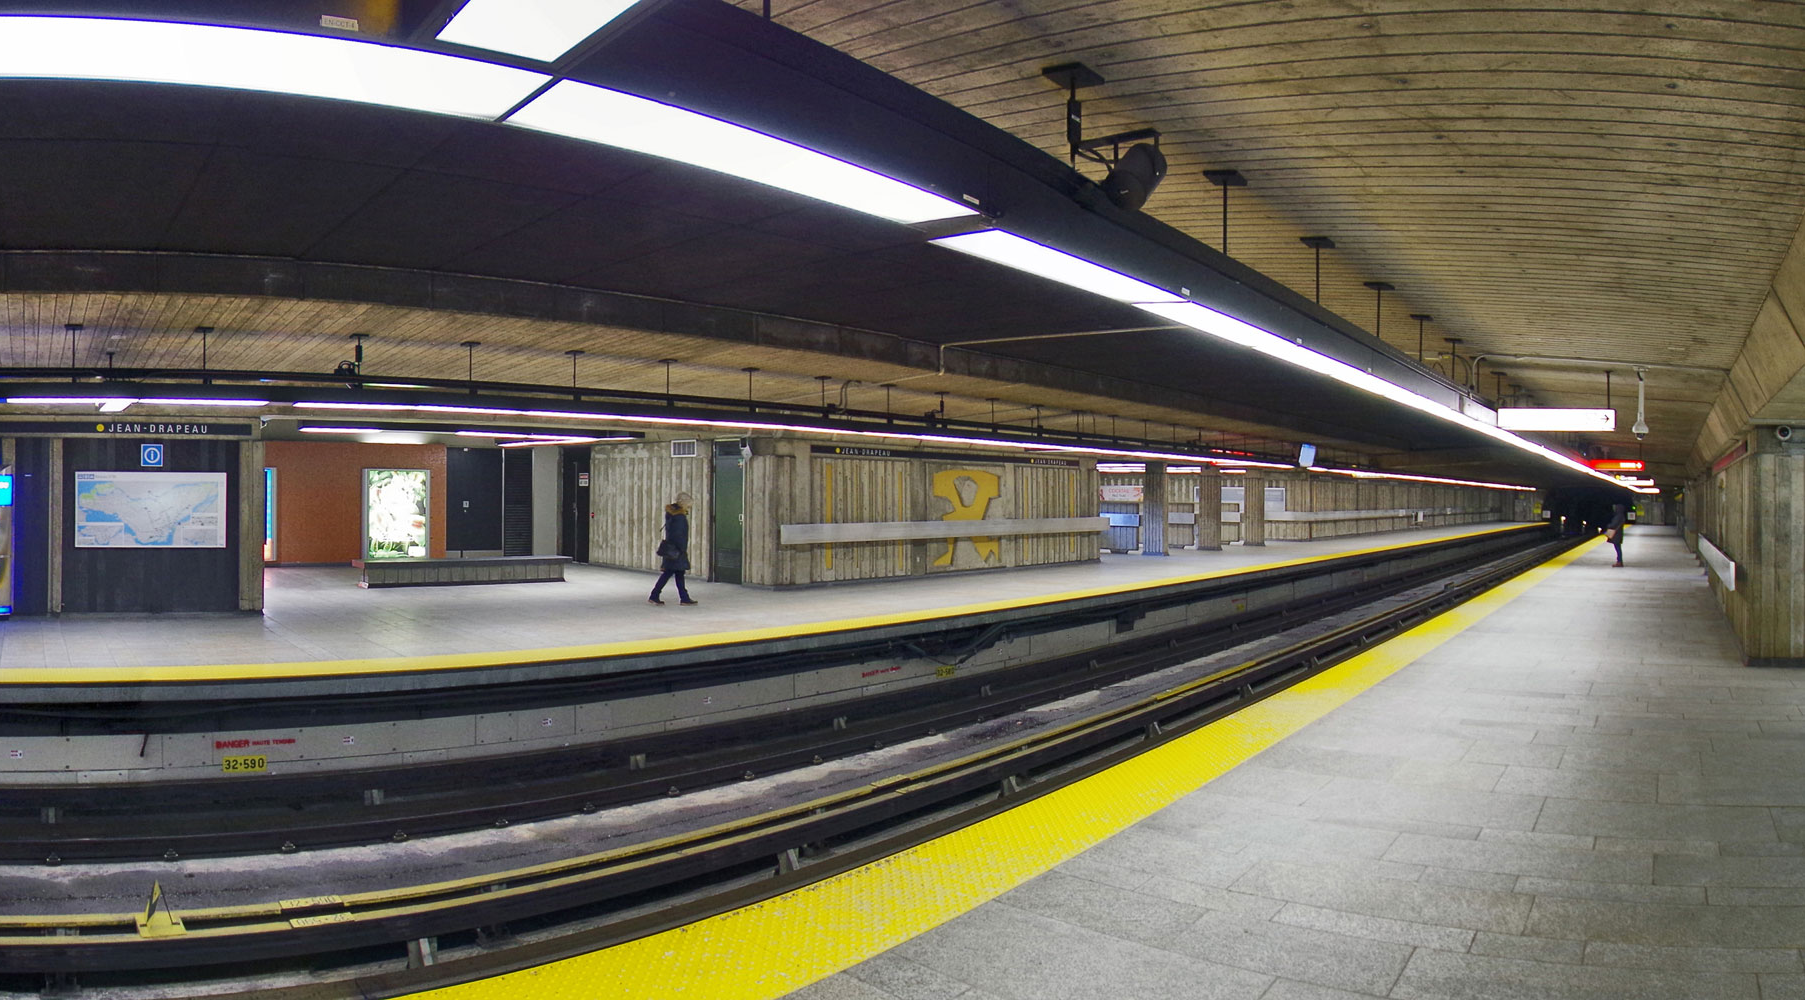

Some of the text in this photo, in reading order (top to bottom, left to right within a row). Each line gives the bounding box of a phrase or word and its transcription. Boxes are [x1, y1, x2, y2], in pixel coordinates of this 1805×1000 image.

[108, 424, 208, 434] JEAN-DRAPEAU
[841, 448, 891, 456] JEAN-DRAPEAU
[215, 739, 250, 749] DANGER
